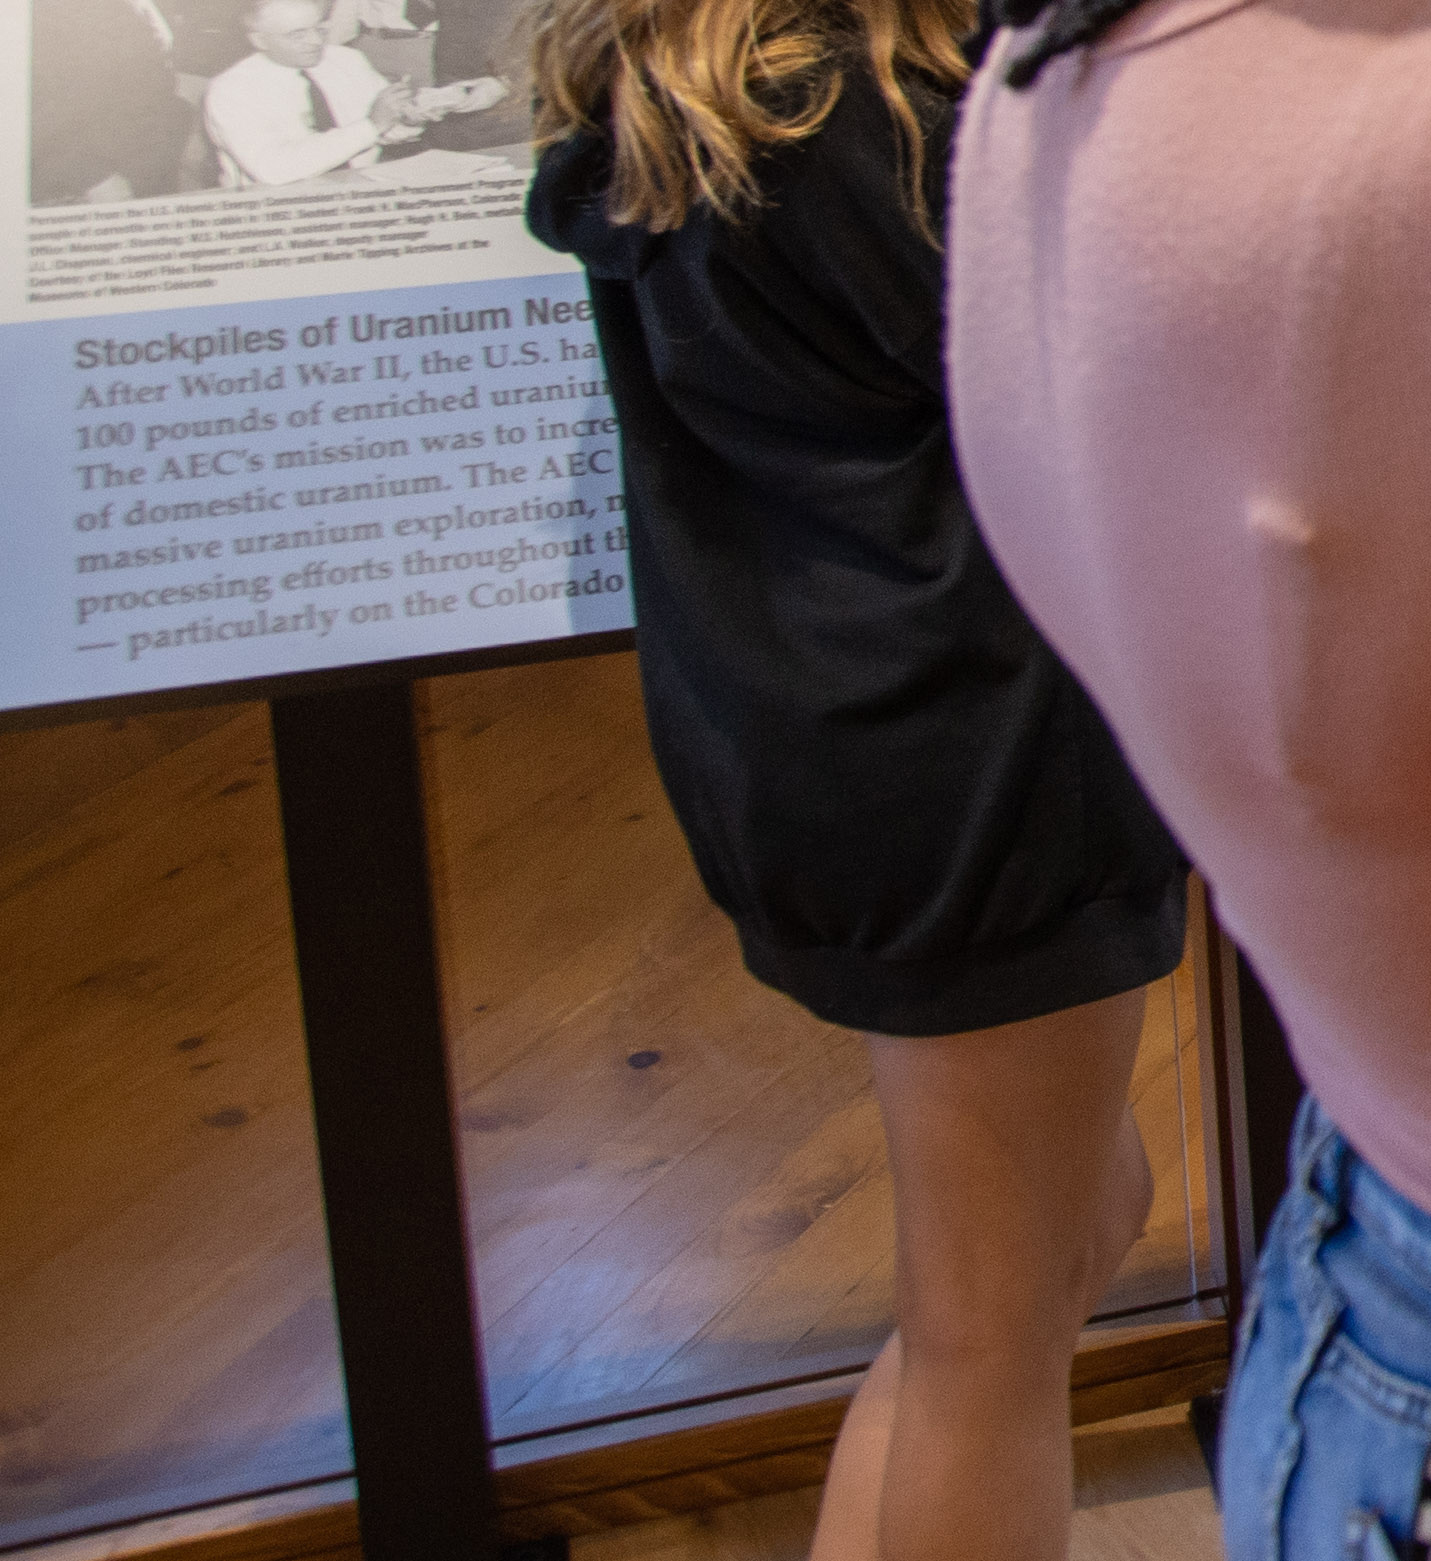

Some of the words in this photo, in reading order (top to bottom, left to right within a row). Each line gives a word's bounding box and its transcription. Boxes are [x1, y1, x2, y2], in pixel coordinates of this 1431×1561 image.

[75, 324, 287, 370] Stockpiles
[300, 316, 340, 348] of
[350, 306, 511, 342] Uranium
[76, 381, 170, 410] After
[180, 365, 286, 397] World
[297, 361, 365, 386] War
[374, 355, 411, 382] II,
[421, 350, 473, 375] the
[482, 340, 549, 369] U.S.
[76, 421, 137, 450] 100
[145, 407, 279, 452] pounds
[287, 400, 324, 429] of
[333, 385, 481, 424] enriched
[75, 462, 147, 490] The
[275, 436, 409, 470] mission
[421, 430, 484, 453] was
[495, 423, 526, 446] to
[75, 502, 115, 532] of
[124, 487, 286, 527] domestic
[295, 473, 451, 507] uranium.
[462, 461, 528, 488] The
[538, 449, 613, 480] AEC
[77, 536, 223, 574] massive
[233, 521, 384, 555] uranium
[394, 496, 597, 542] exploration,
[77, 573, 273, 625] processing
[281, 557, 394, 591] efforts
[403, 532, 595, 574] throughout
[128, 602, 340, 662] particularly
[350, 602, 393, 625] on
[403, 590, 458, 618] the
[468, 568, 624, 609] Colorado
